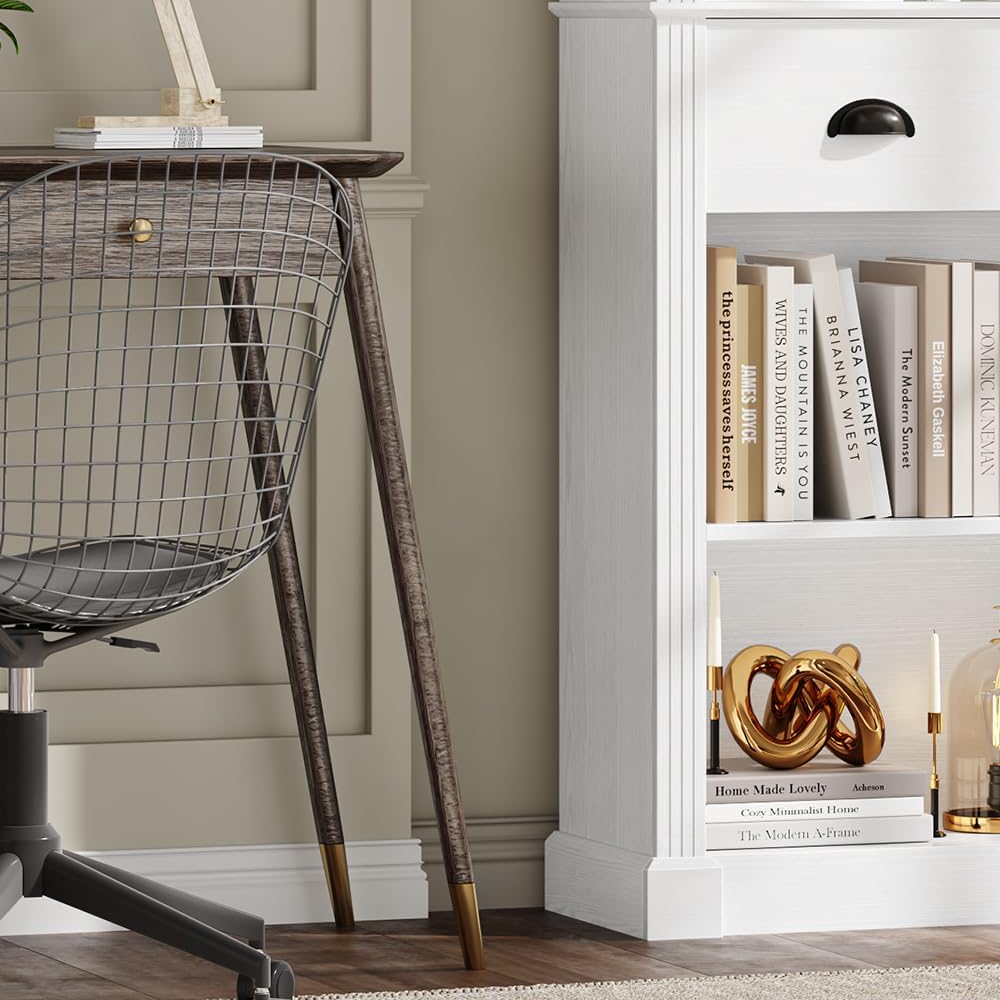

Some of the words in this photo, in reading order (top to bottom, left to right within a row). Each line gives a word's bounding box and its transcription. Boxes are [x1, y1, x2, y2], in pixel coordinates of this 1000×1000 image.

[722, 291, 733, 317] the
[775, 299, 787, 346] WIVES
[798, 308, 808, 335] THE
[775, 350, 787, 382] AND
[901, 349, 912, 371] The
[932, 341, 945, 404] Elizabeth
[980, 324, 994, 391] DOMINIC
[741, 364, 757, 404] JAMES
[798, 345, 808, 436] MOUNTAIN
[826, 315, 848, 400] BRIANNA
[842, 408, 860, 461] WIEST
[848, 327, 863, 368] LISA
[856, 376, 878, 447] CHANEY
[901, 376, 912, 424] Modern
[741, 407, 757, 444] JOYCE
[775, 385, 787, 476] DAUGHTERS
[932, 407, 945, 457] Gaskell
[722, 434, 734, 491] herself
[798, 443, 808, 458] IS
[901, 427, 913, 469] Sunset
[798, 464, 808, 500] YOU
[715, 785, 750, 797] Home
[753, 784, 785, 796] Made
[789, 782, 828, 797] Lovely
[852, 783, 885, 792] Acheson
[740, 808, 766, 819] Cozy
[769, 806, 823, 817] Minimalist
[827, 804, 860, 814] Home
[738, 829, 761, 842] The
[765, 829, 810, 841] Modern
[813, 827, 861, 839] A-Frame
